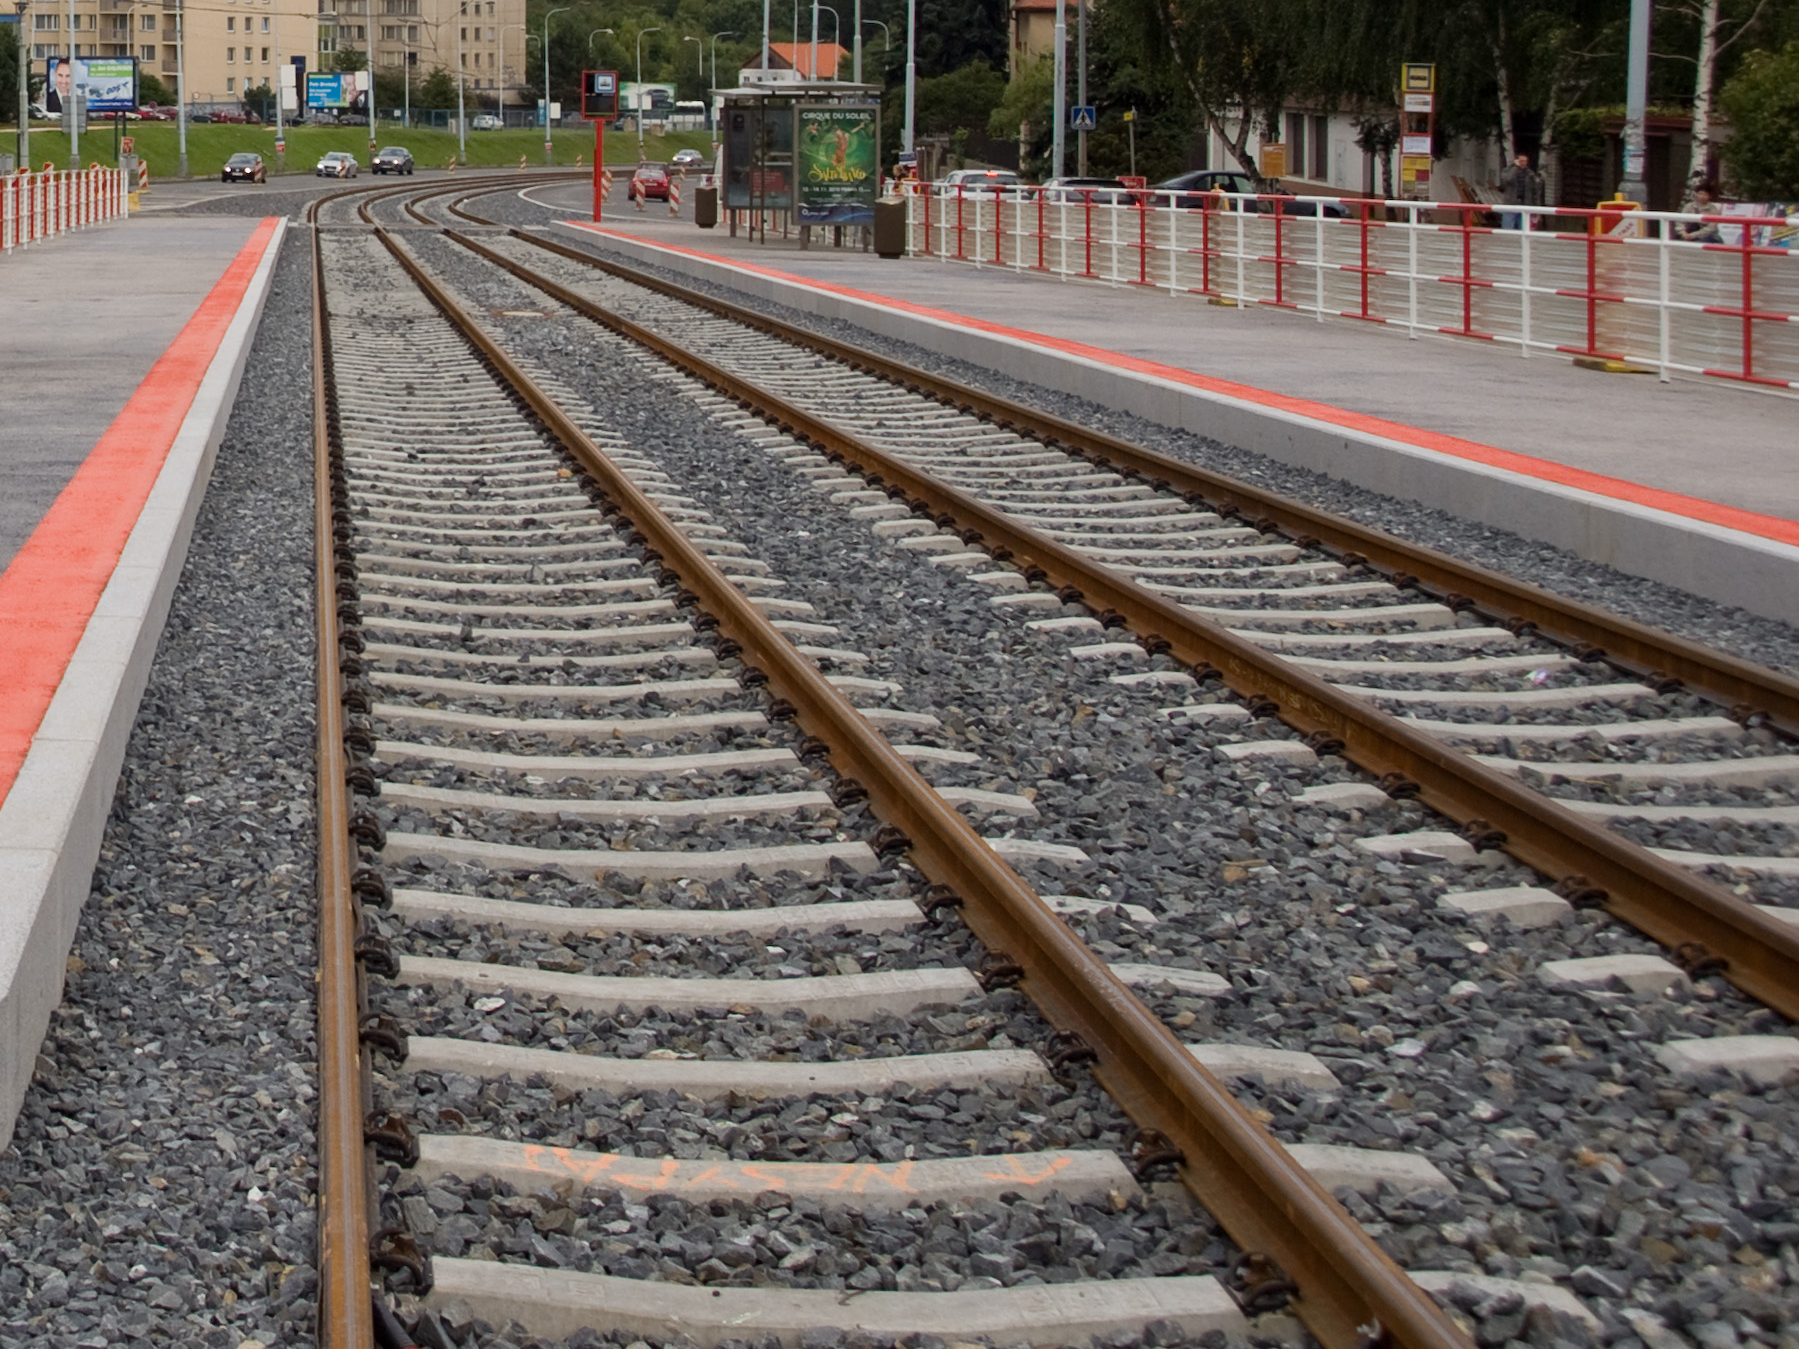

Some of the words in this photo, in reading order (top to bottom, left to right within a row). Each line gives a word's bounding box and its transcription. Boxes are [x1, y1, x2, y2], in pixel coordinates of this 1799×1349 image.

[802, 112, 831, 121] CIRQUE
[832, 112, 845, 120] DU
[845, 112, 871, 120] SOLEIL
